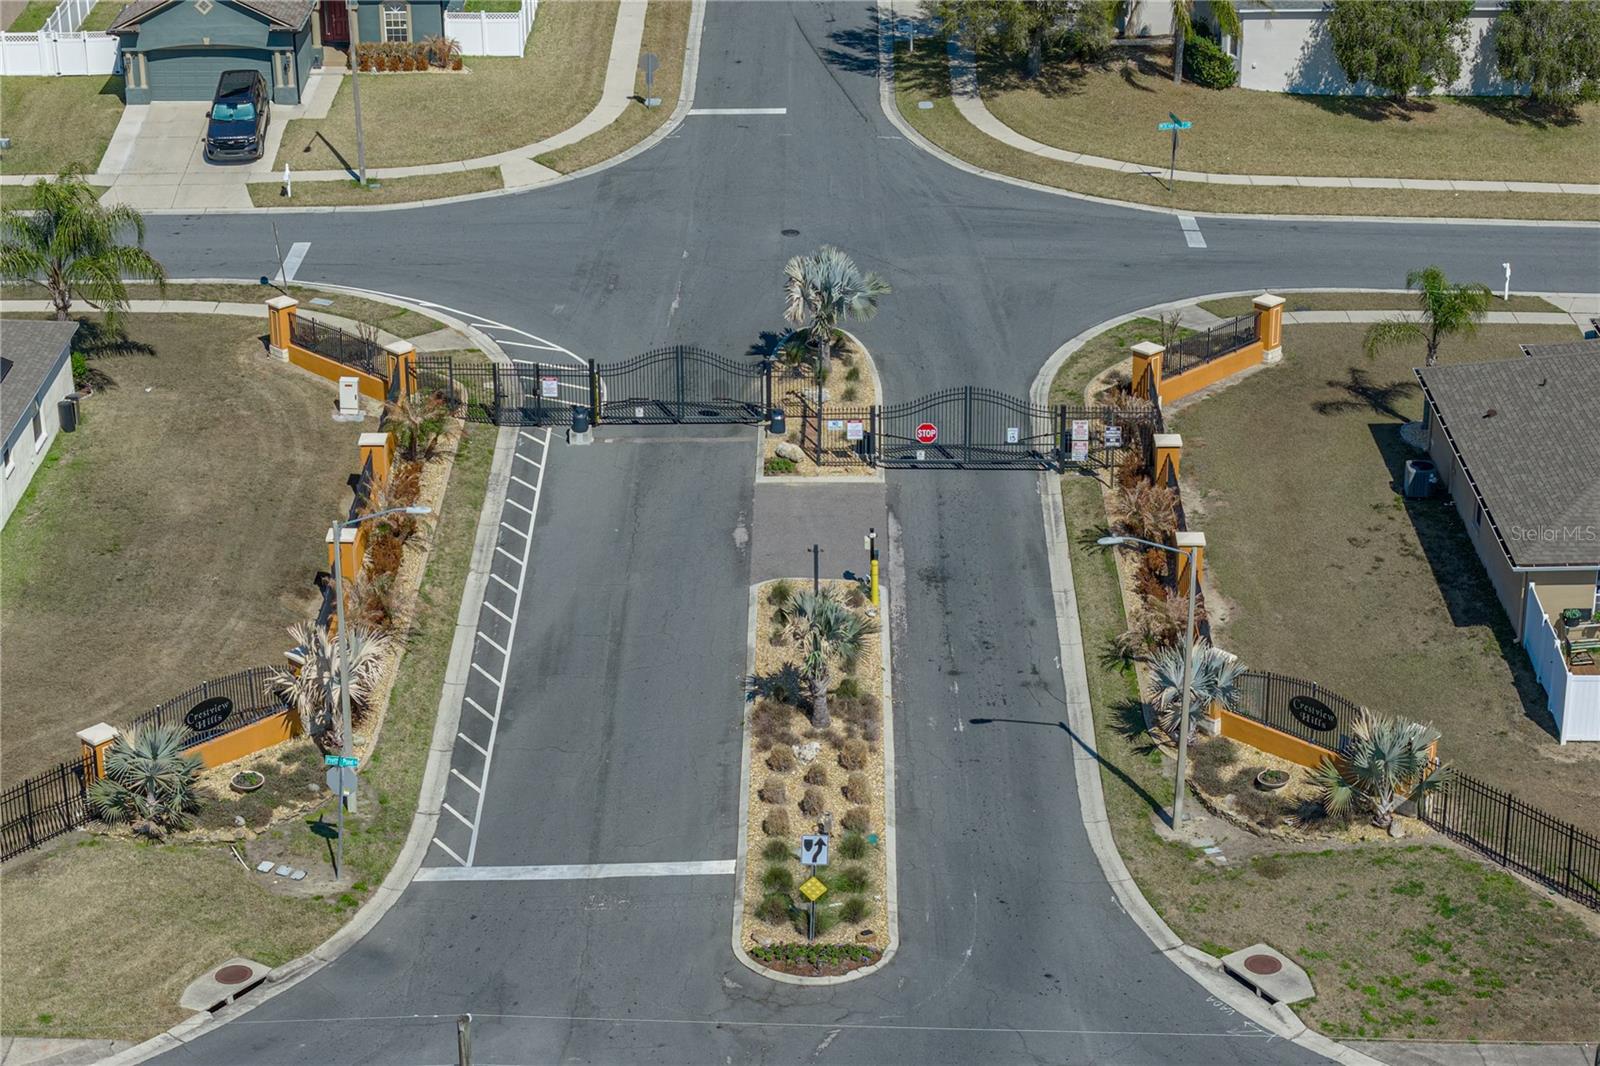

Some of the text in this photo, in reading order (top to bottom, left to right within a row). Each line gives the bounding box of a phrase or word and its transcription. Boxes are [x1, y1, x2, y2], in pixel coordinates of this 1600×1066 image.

[917, 428, 936, 438] STOP
[186, 701, 230, 725] Crestview
[1293, 698, 1335, 721] Crestview
[195, 713, 223, 730] Hills
[1300, 710, 1327, 729] Hills
